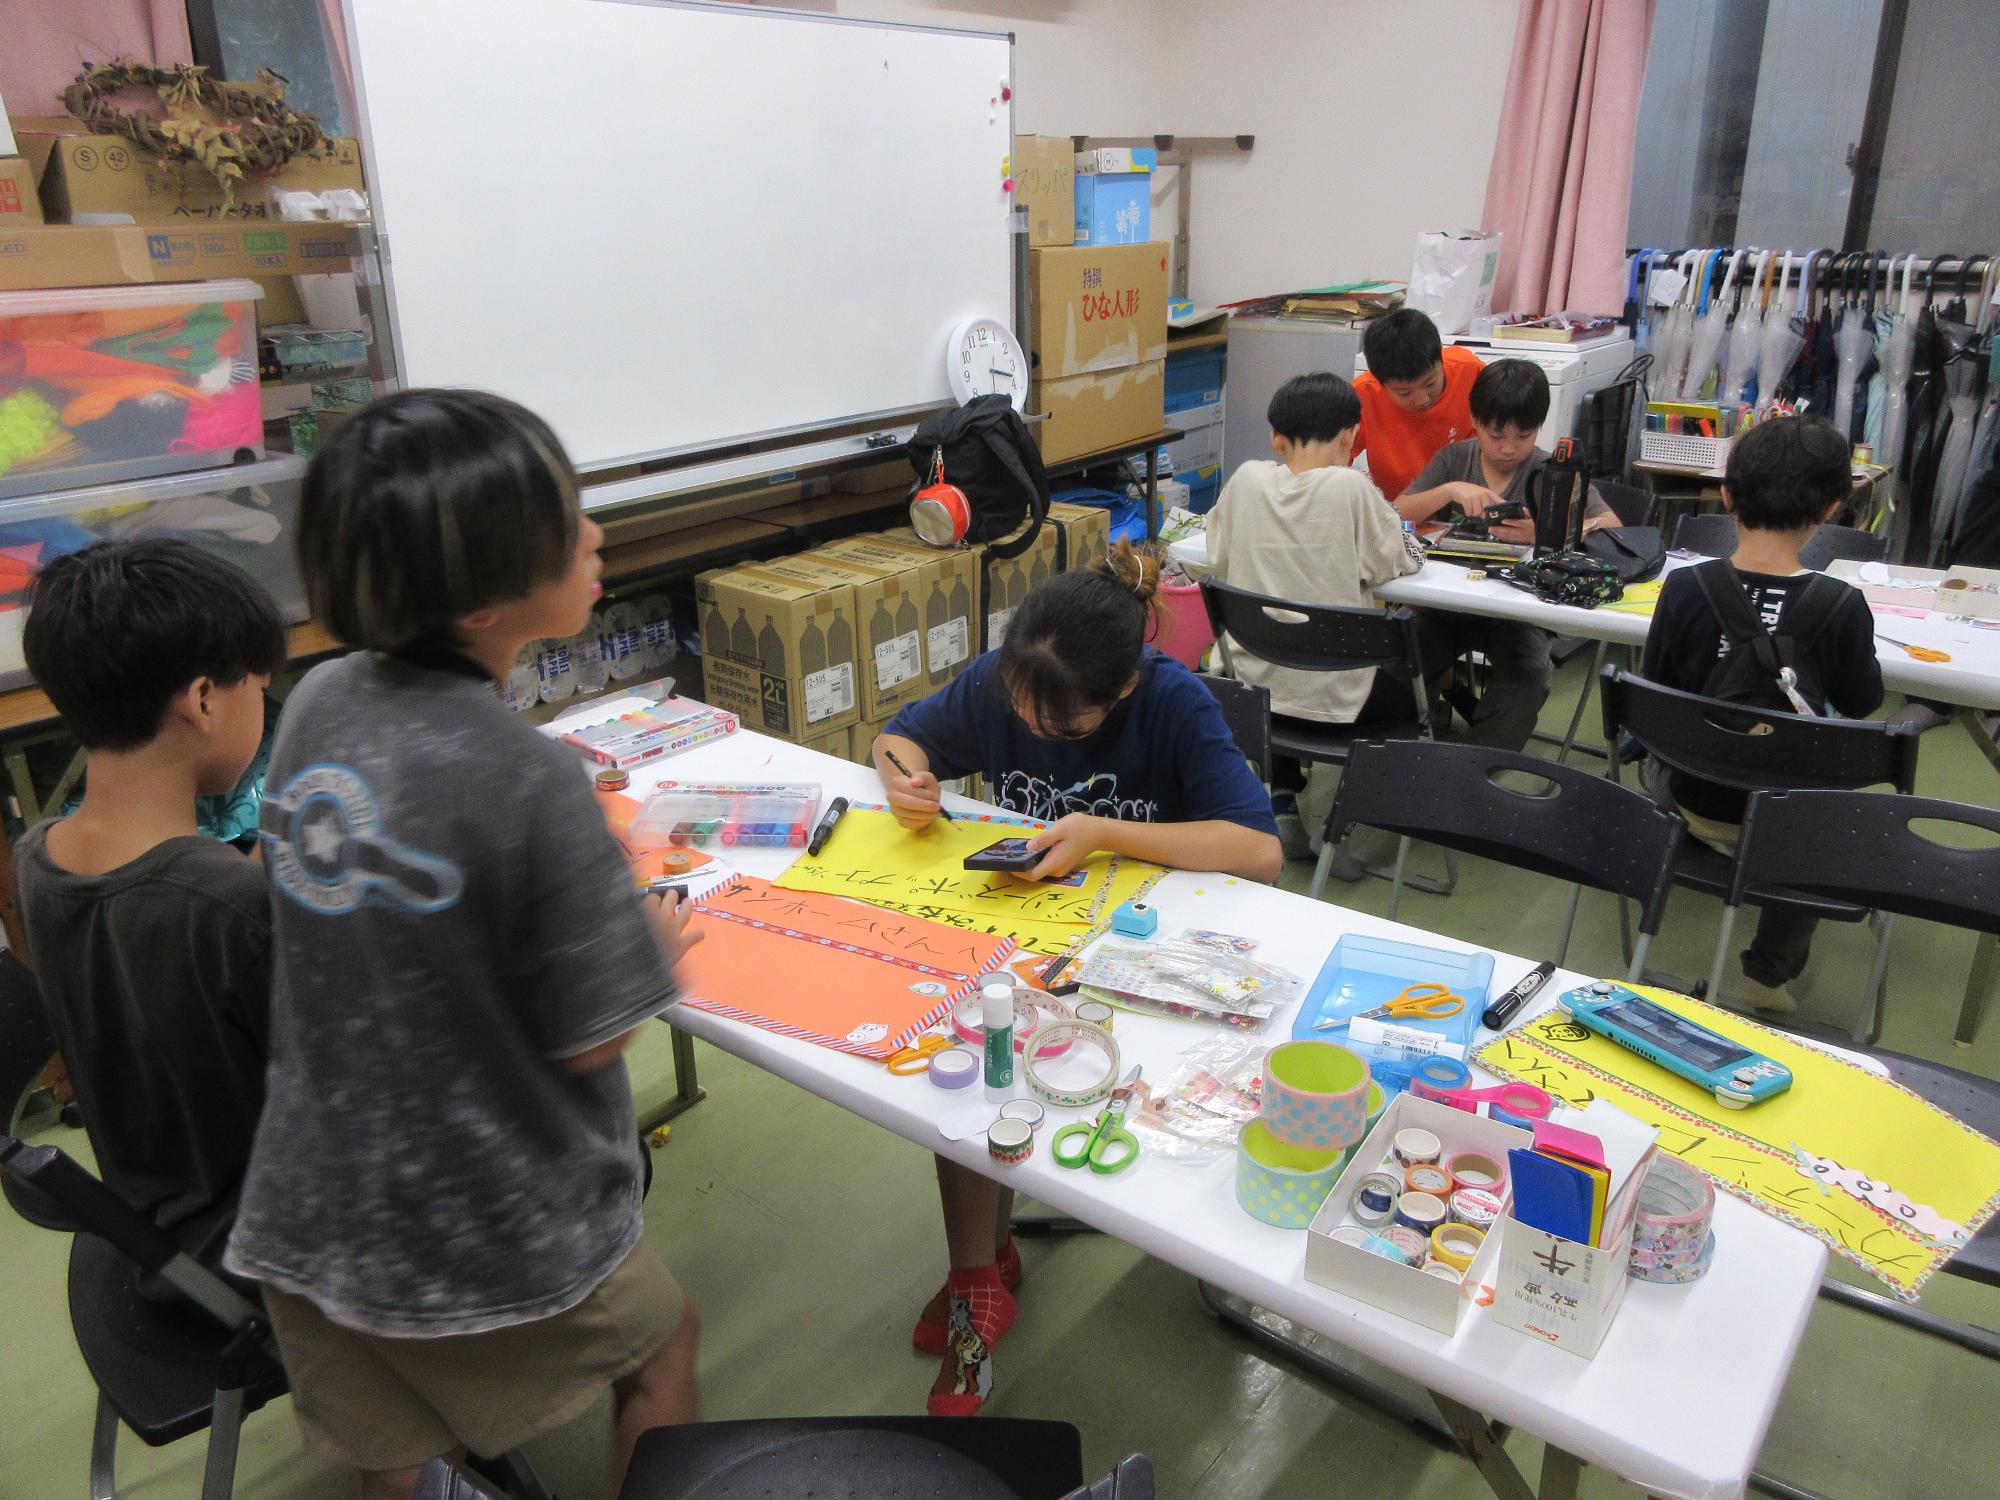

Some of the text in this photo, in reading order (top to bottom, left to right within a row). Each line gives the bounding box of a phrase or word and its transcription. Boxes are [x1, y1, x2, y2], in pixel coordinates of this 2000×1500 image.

[80, 150, 91, 162] S
[1015, 168, 1070, 195] スリッパ
[1081, 287, 1141, 323] ひな人形
[976, 327, 987, 341] 12
[967, 336, 977, 349] 11
[1002, 342, 1009, 355] 2
[961, 350, 972, 365] 10
[1009, 359, 1016, 372] 3
[964, 370, 971, 383] 9
[1011, 377, 1017, 390] 4
[972, 387, 979, 397] 8
[627, 625, 640, 653] TOILET
[546, 647, 559, 678] PAPER
[557, 643, 570, 674] TOILET
[763, 677, 786, 706] 2L
[726, 721, 734, 729] 10
